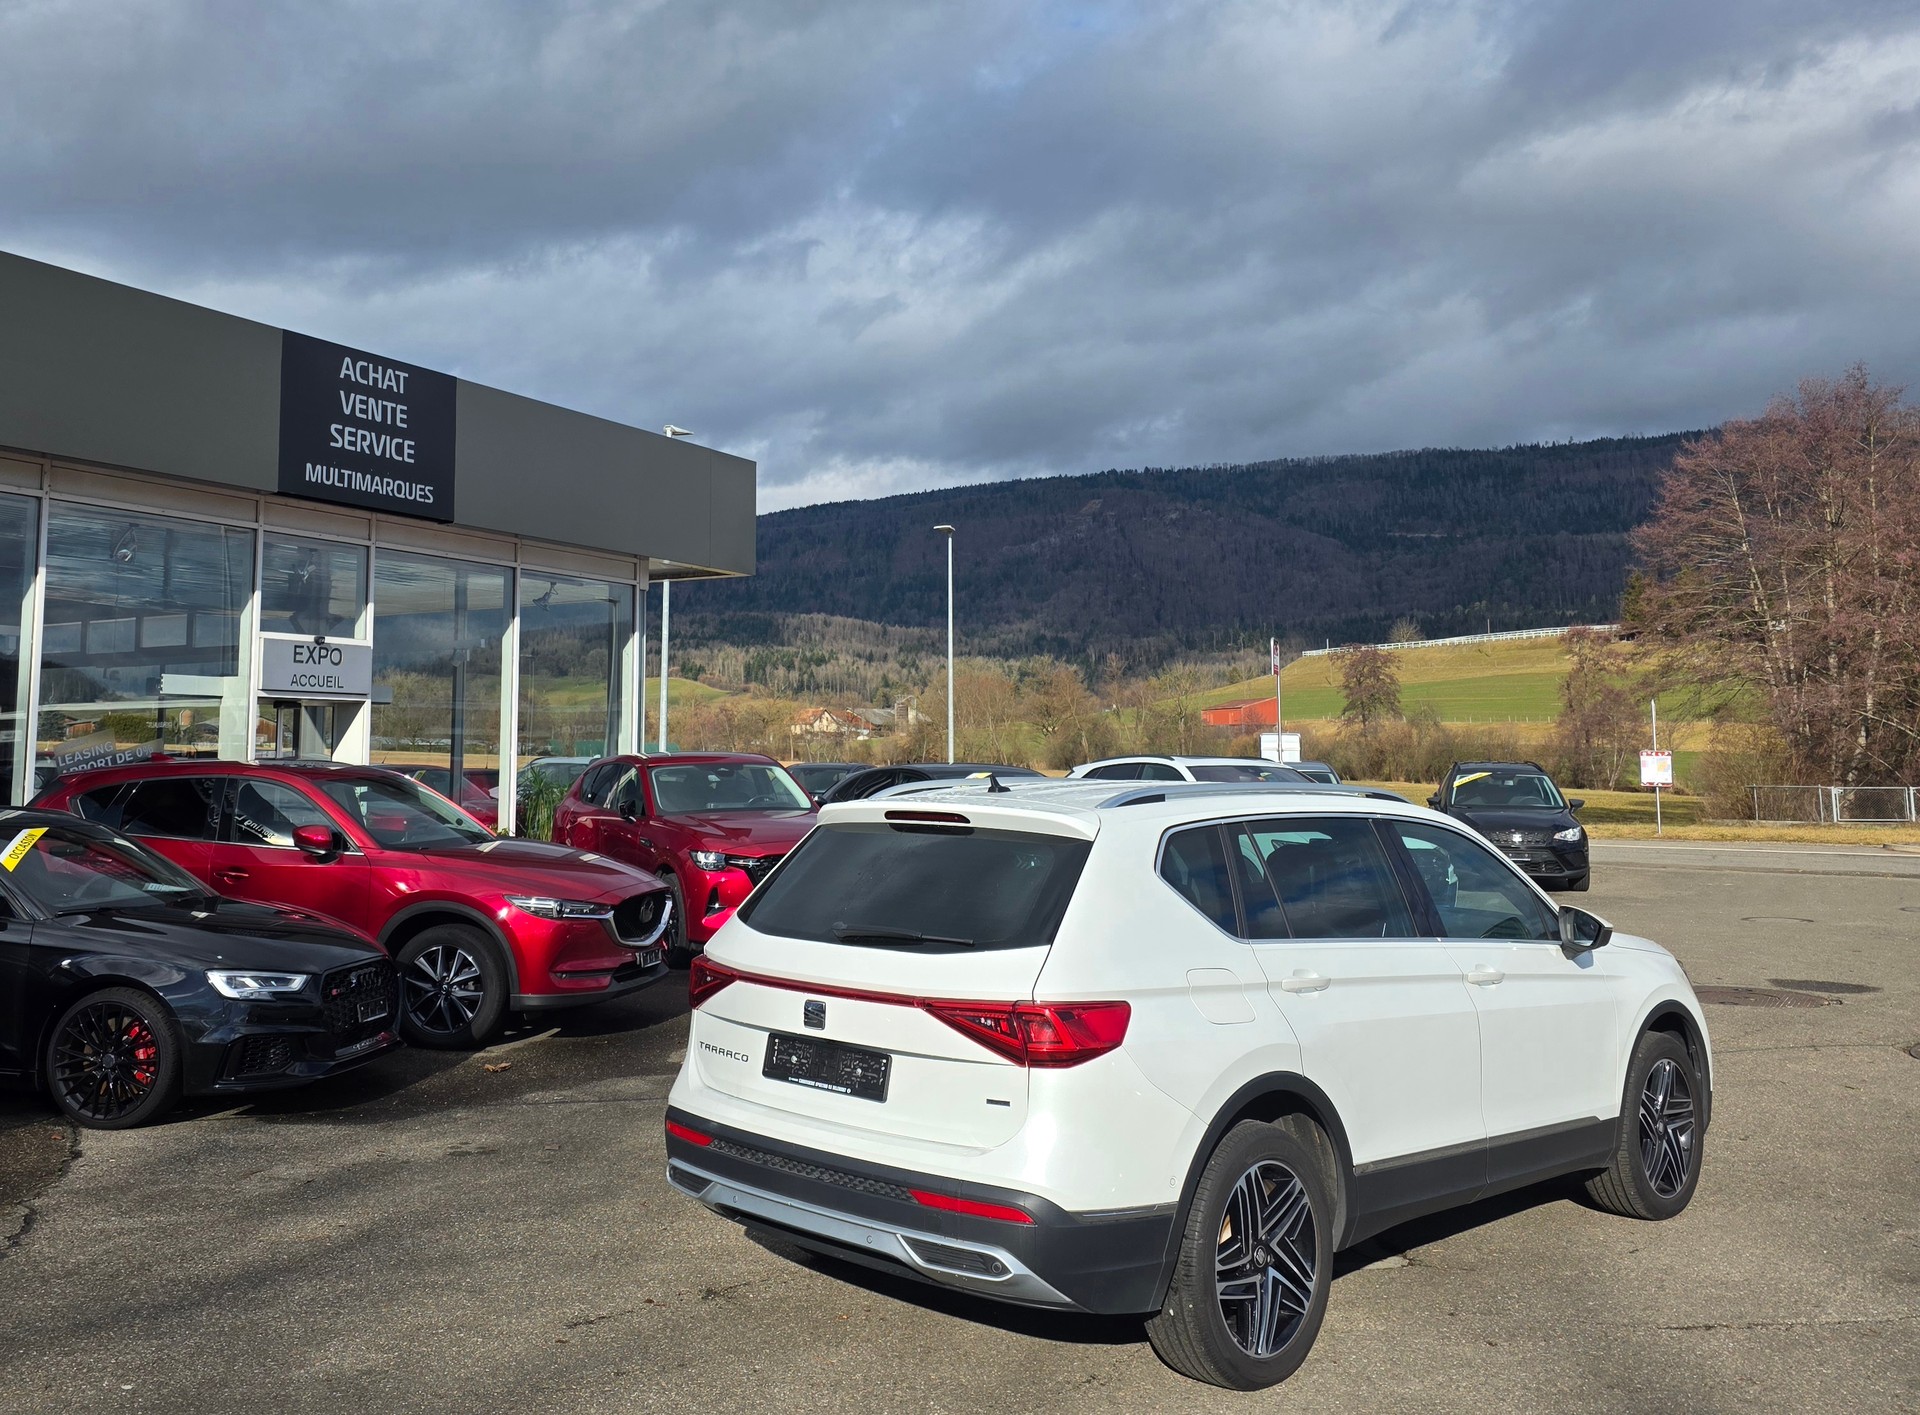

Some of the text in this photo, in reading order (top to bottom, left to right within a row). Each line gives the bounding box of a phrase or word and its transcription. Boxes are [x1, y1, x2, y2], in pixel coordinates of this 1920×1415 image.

[340, 356, 408, 394] ACHAT
[340, 390, 408, 428] VENTE
[330, 423, 415, 463] SERVICE
[305, 462, 434, 503] MULTIMARQUES
[293, 645, 343, 666] EXPO
[290, 674, 344, 688] ACCUEIL
[58, 742, 113, 767] LEASING
[63, 756, 112, 774] PORT
[116, 751, 134, 764] DE
[699, 1041, 749, 1063] TARRACO
